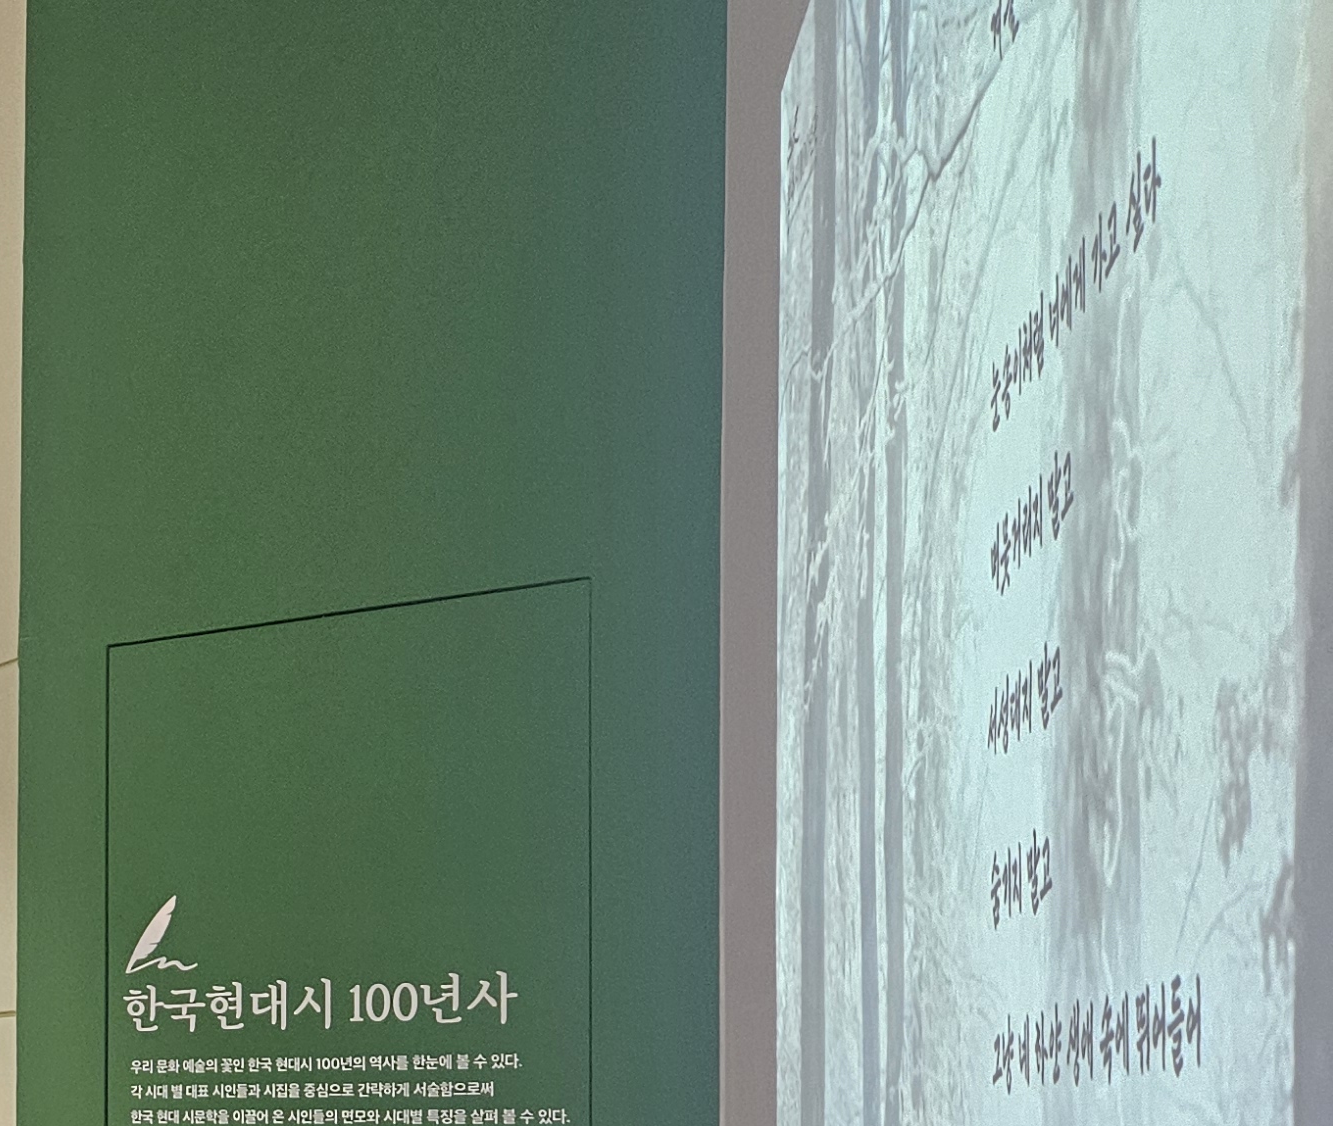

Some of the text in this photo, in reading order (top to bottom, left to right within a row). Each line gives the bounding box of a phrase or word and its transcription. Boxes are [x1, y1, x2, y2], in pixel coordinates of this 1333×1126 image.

[991, 136, 1161, 432] 눈송이처럼 너에게 가고 싶다
[990, 451, 1074, 596] 머뭇거리지 말고
[987, 641, 1063, 755] 서성대지 말고
[991, 828, 1053, 931] 숨기지 말고
[123, 970, 519, 1033] 한국현대시 100년사
[992, 973, 1201, 1095] 그냥 네 하얀 생애 속에 뛰어들어
[130, 1053, 523, 1074] 우리 문화 예술의 꽃인 한국 현대시 100년의 역사를 한눈에 볼 수 있다.
[130, 1081, 494, 1099] 각 시대 별 대표 시인들과 시집을 중심으로 간략하게 서술함으로써
[130, 1108, 570, 1124] 한국 현대 시문학을 이끌어 온 시인들의 면모와 시대별 특징을 살펴 볼 수 있다.
